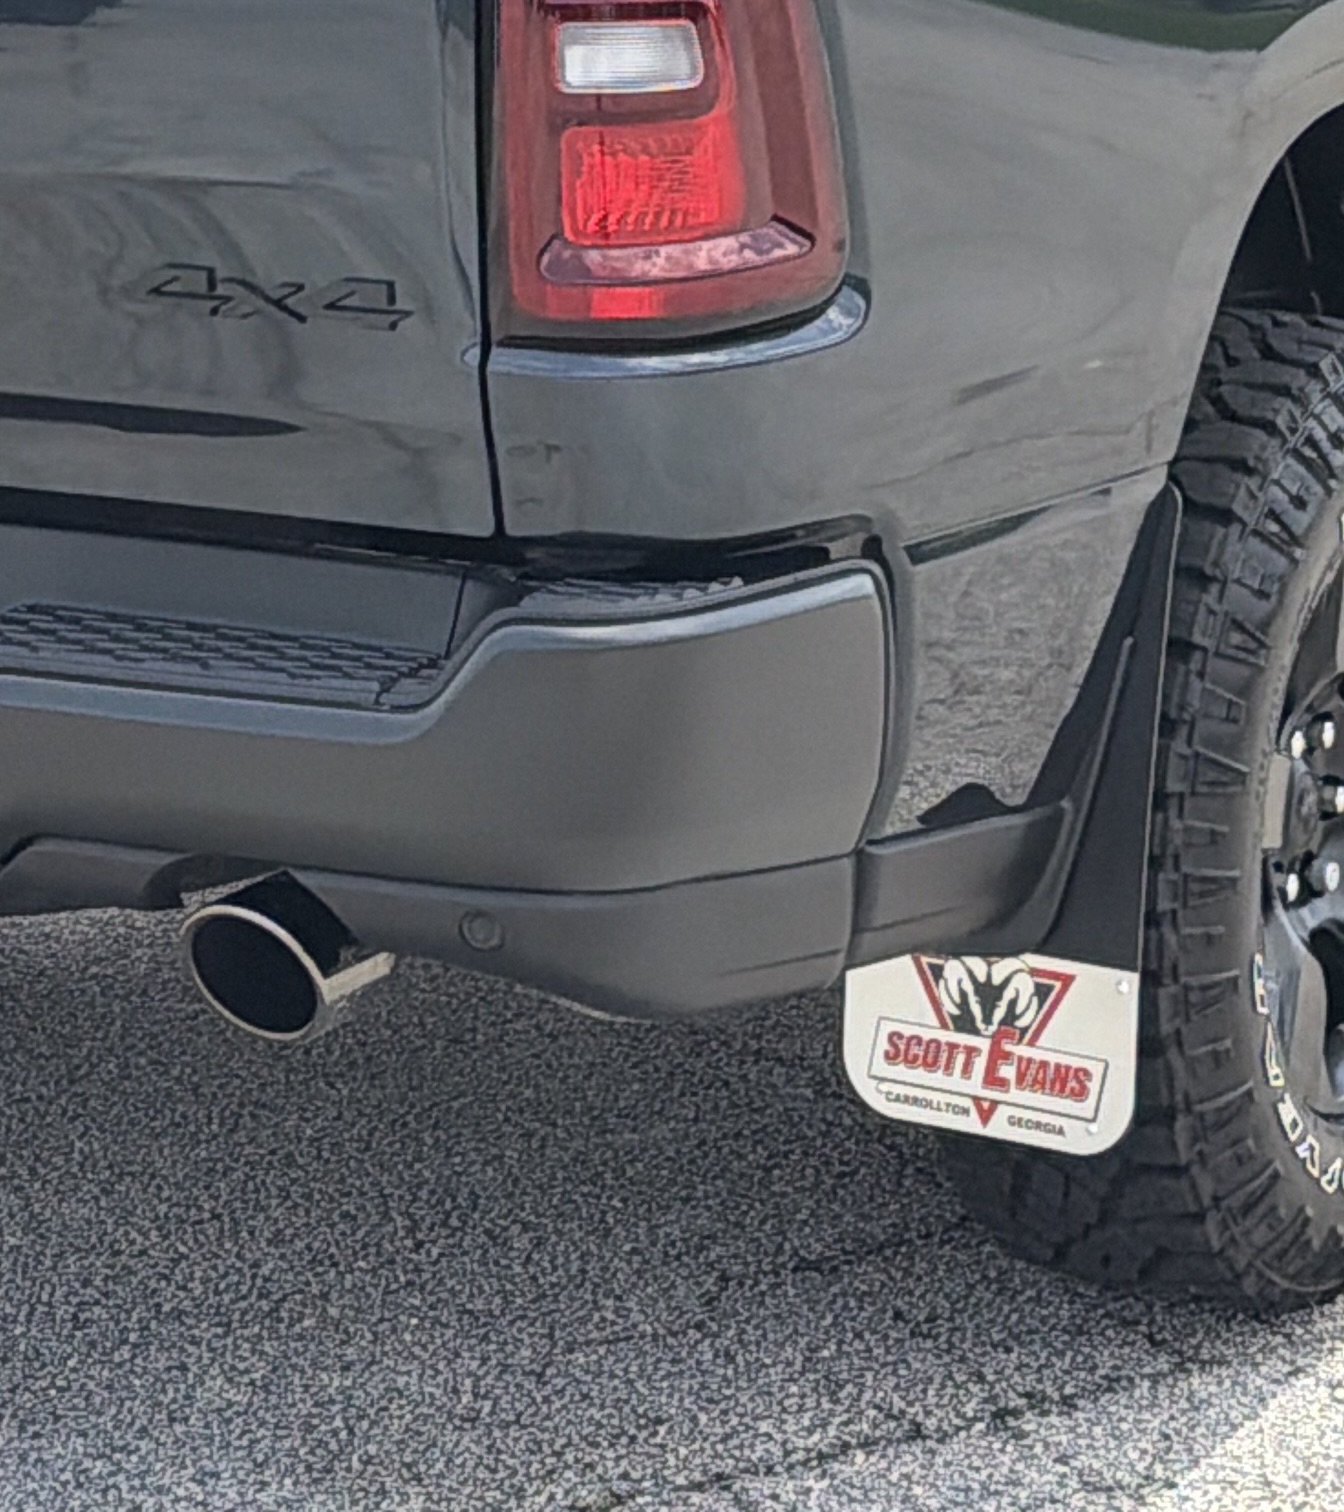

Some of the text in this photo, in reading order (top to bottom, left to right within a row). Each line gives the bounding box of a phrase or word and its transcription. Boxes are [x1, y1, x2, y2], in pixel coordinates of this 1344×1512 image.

[883, 1024, 1093, 1103] SCOTT EVANS
[885, 1090, 1066, 1137] CARROLLTON GEORGIA
